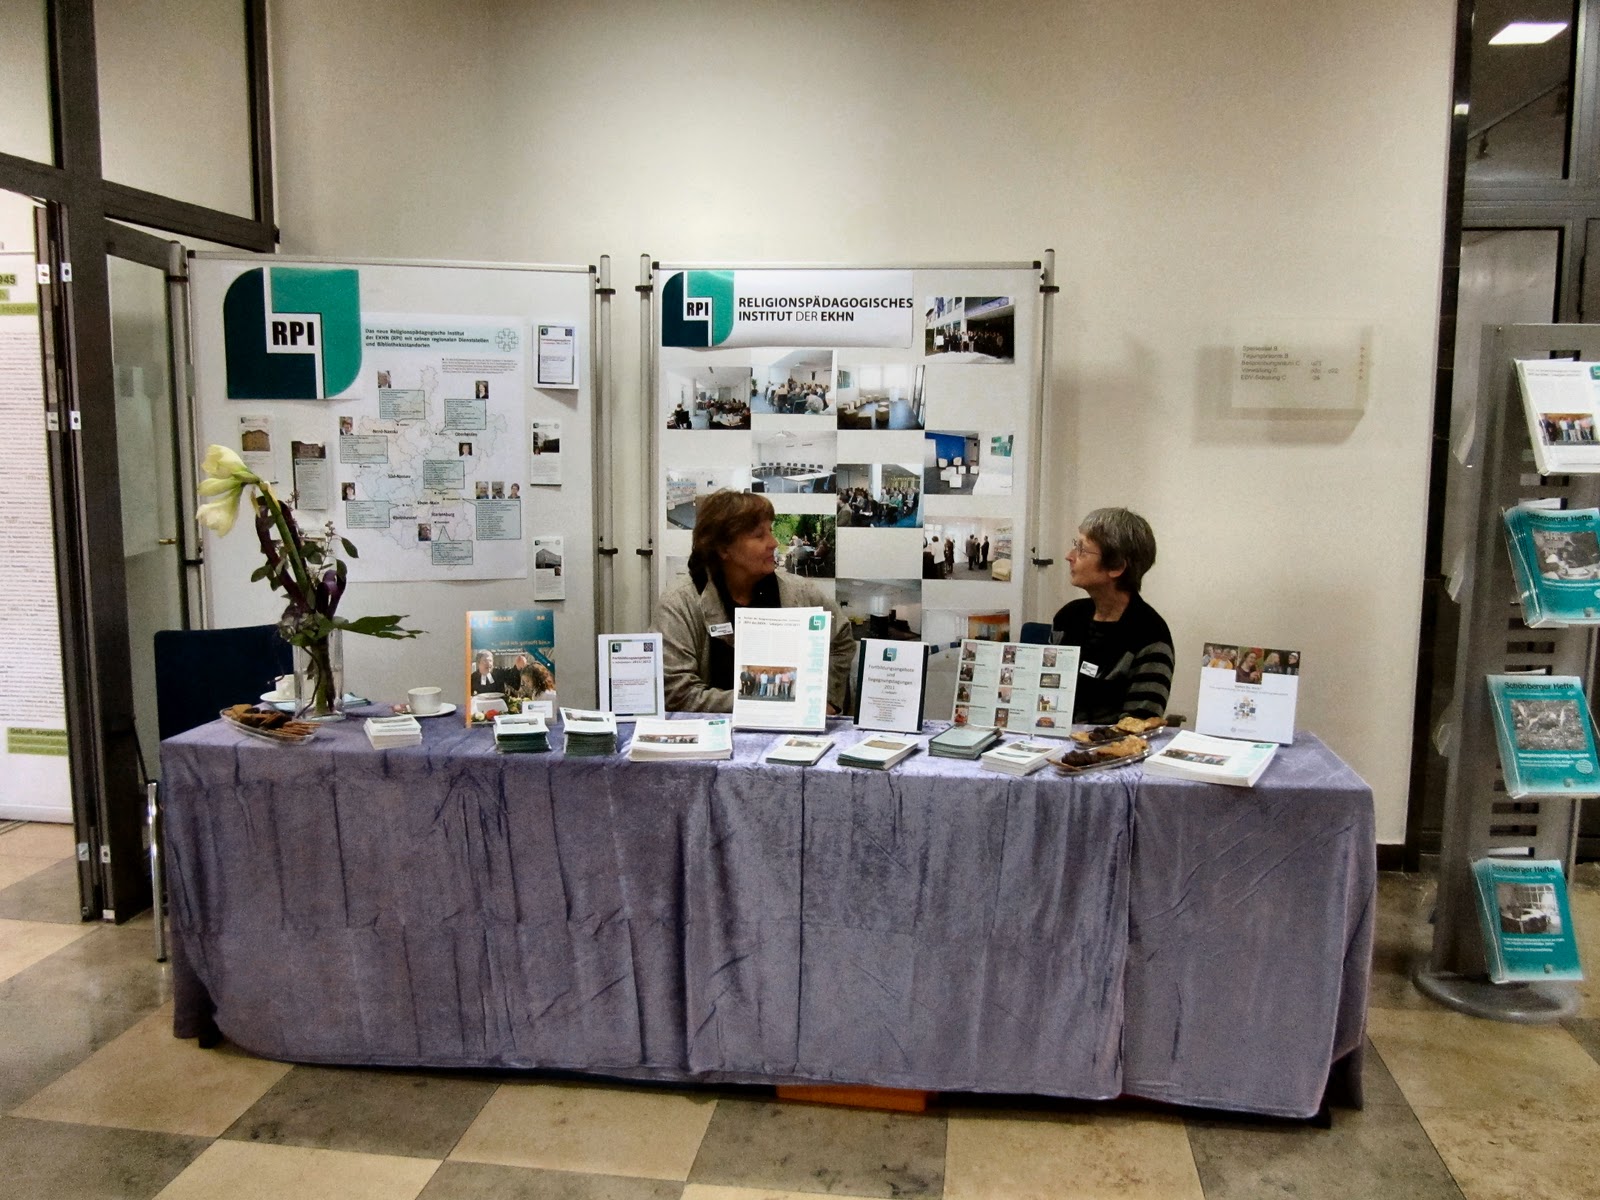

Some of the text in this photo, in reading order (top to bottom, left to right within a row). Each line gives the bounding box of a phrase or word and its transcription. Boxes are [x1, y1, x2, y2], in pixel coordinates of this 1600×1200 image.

[738, 295, 913, 308] RELIGIONSPÄDAGOGISCHES
[686, 301, 709, 316] RPI
[738, 311, 854, 321] INSTITUT DER EKHN
[272, 321, 315, 346] RPI
[1504, 681, 1551, 691] Schönberger
